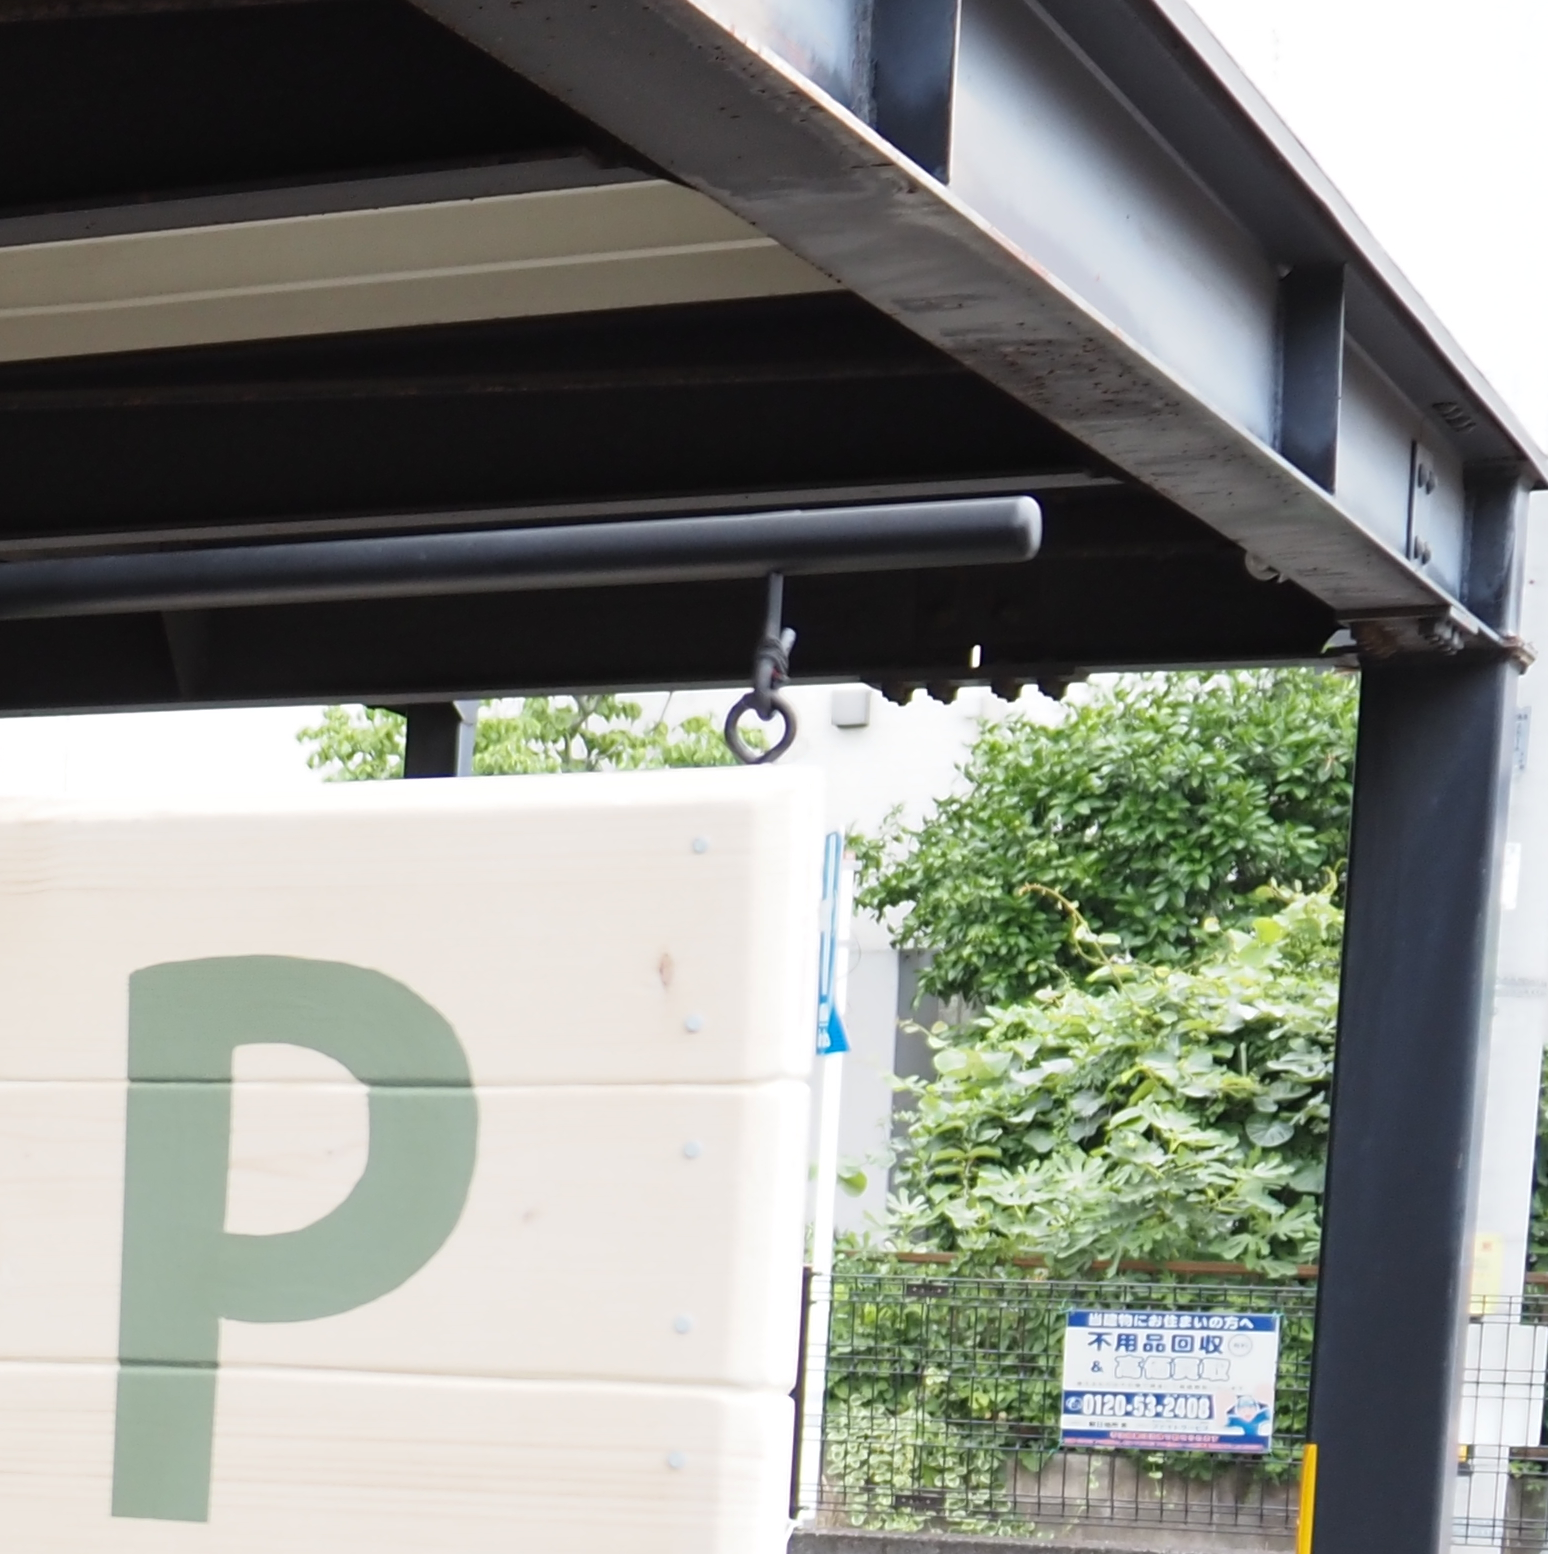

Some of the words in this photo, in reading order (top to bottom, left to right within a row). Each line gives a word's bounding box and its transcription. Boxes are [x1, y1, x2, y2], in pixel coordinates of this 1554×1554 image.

[112, 954, 480, 1523] P
[1087, 1331, 1224, 1355] 不用品回収
